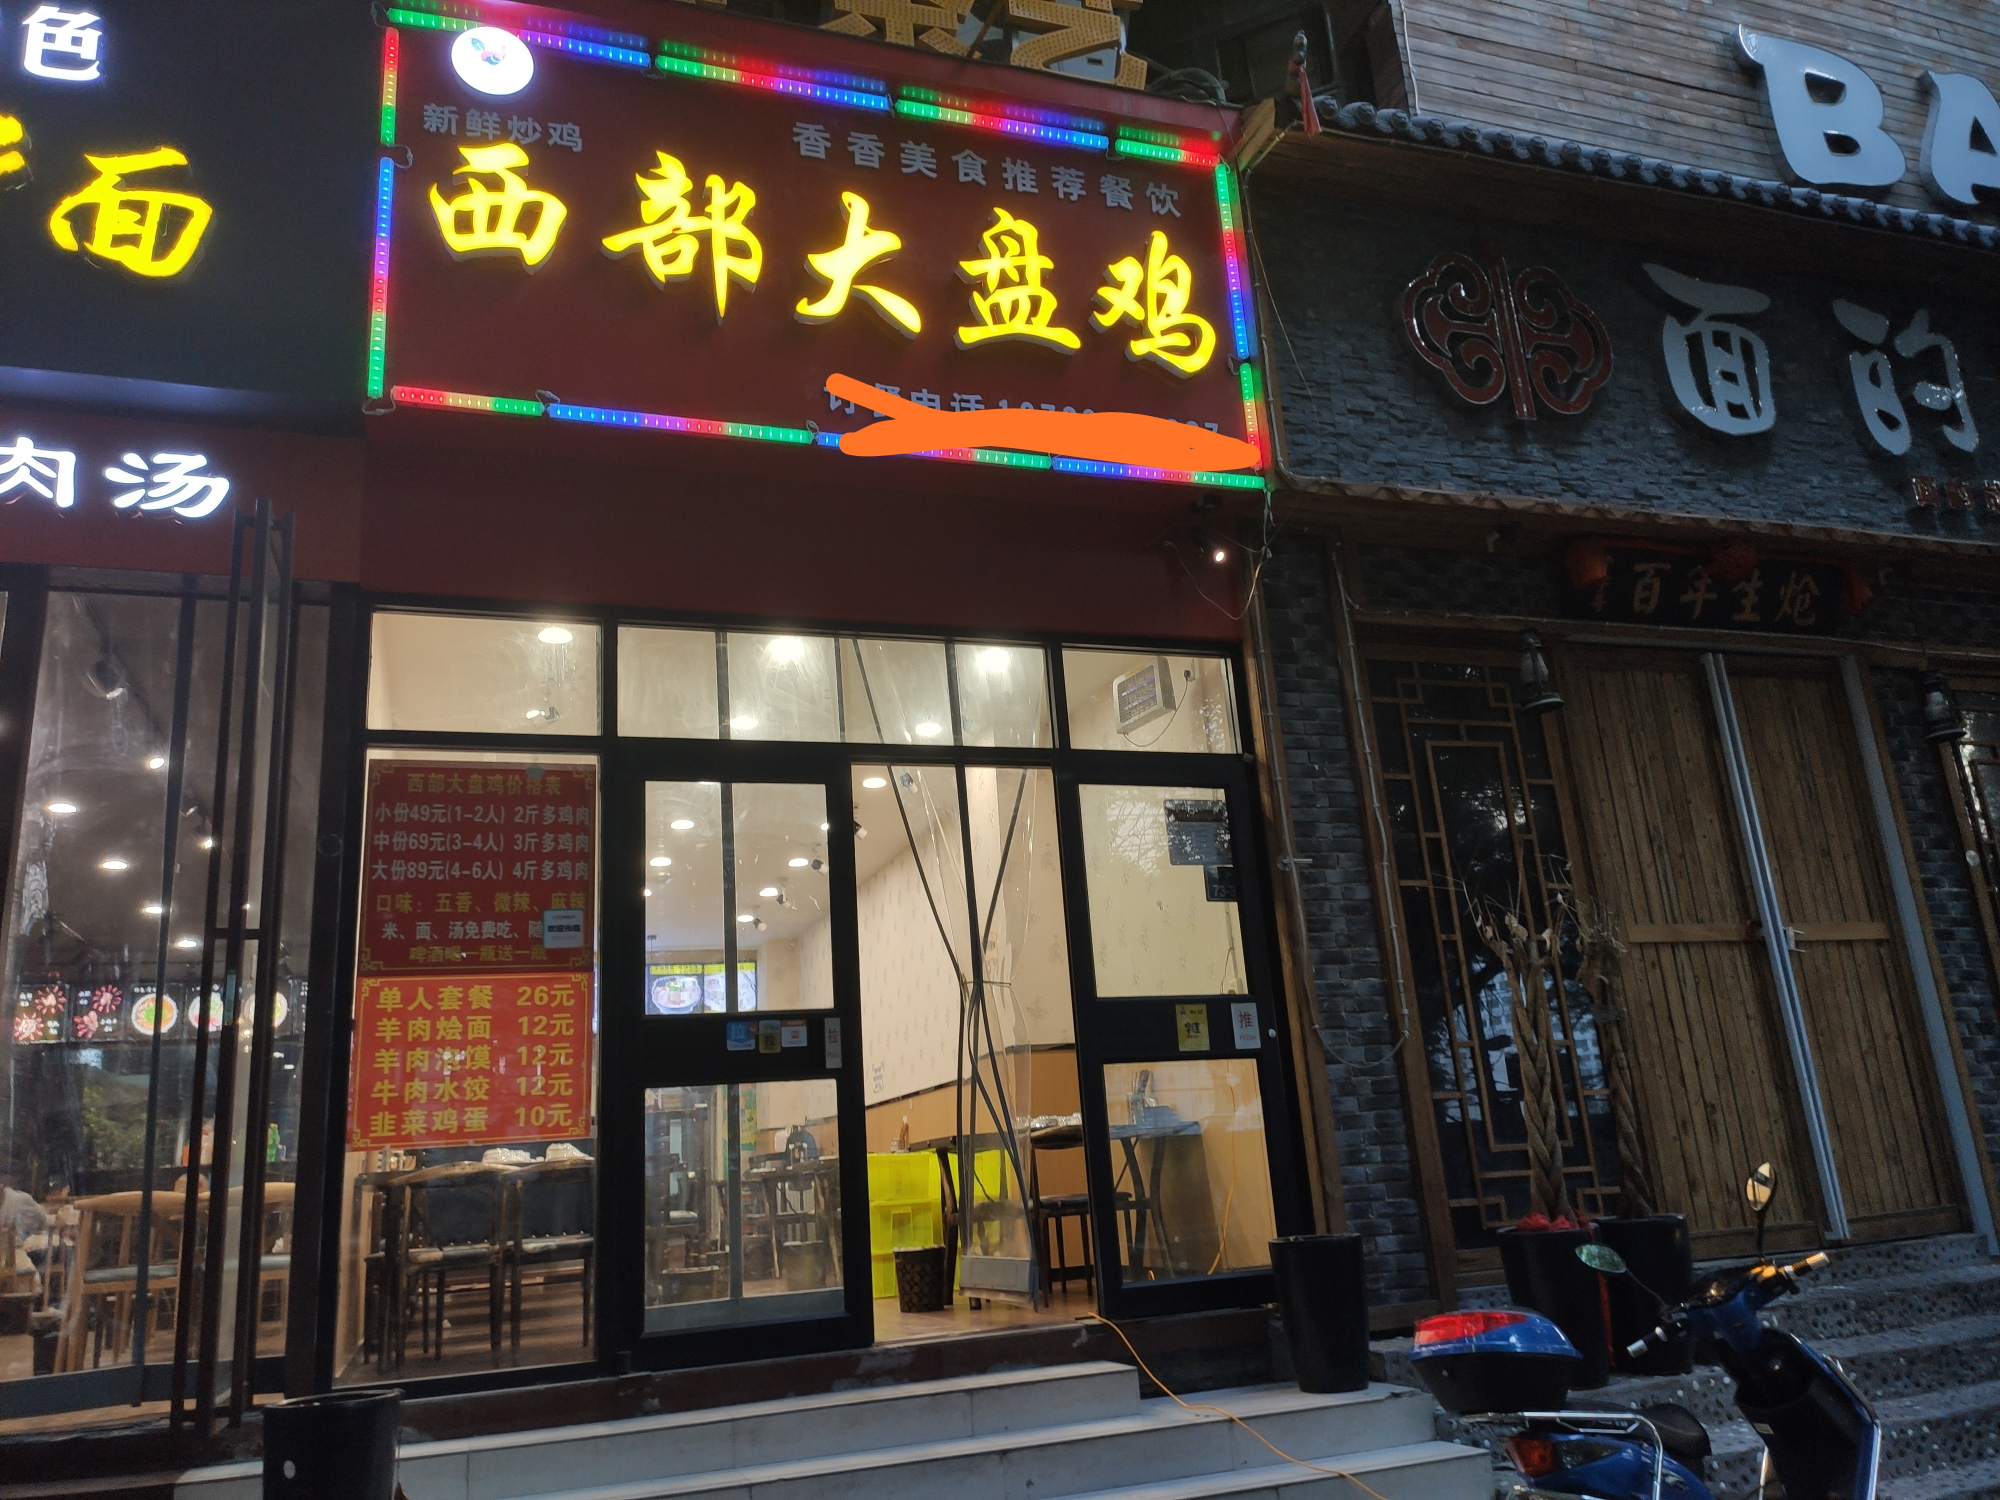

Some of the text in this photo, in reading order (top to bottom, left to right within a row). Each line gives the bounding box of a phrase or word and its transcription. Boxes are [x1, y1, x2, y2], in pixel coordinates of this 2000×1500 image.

[22, 5, 102, 81] 色
[423, 103, 583, 152] 新鲜炒鸡
[793, 121, 1182, 219] 香香美食推荐餐饮
[428, 142, 1217, 376] 西部大盘鸡
[0, 437, 231, 518] 肉汤
[407, 773, 561, 795] 西部大盘鸡价格表
[514, 805, 589, 826] 2斤多鸡肉
[514, 833, 589, 852] 3斤多鸡肉
[513, 860, 588, 881] 4斤多鸡肉
[376, 984, 575, 1012] 单人套餐 26元
[375, 1013, 574, 1043] 羊肉烩面 12元
[730, 1023, 746, 1040] 拉
[1238, 1011, 1254, 1029] 推
[828, 1028, 839, 1044] 拉
[374, 1042, 574, 1074] 羊肉泡馍 12元
[371, 1072, 573, 1105] 牛肉水饺 12元
[369, 1103, 572, 1137] 韭菜鸡蛋 10元
